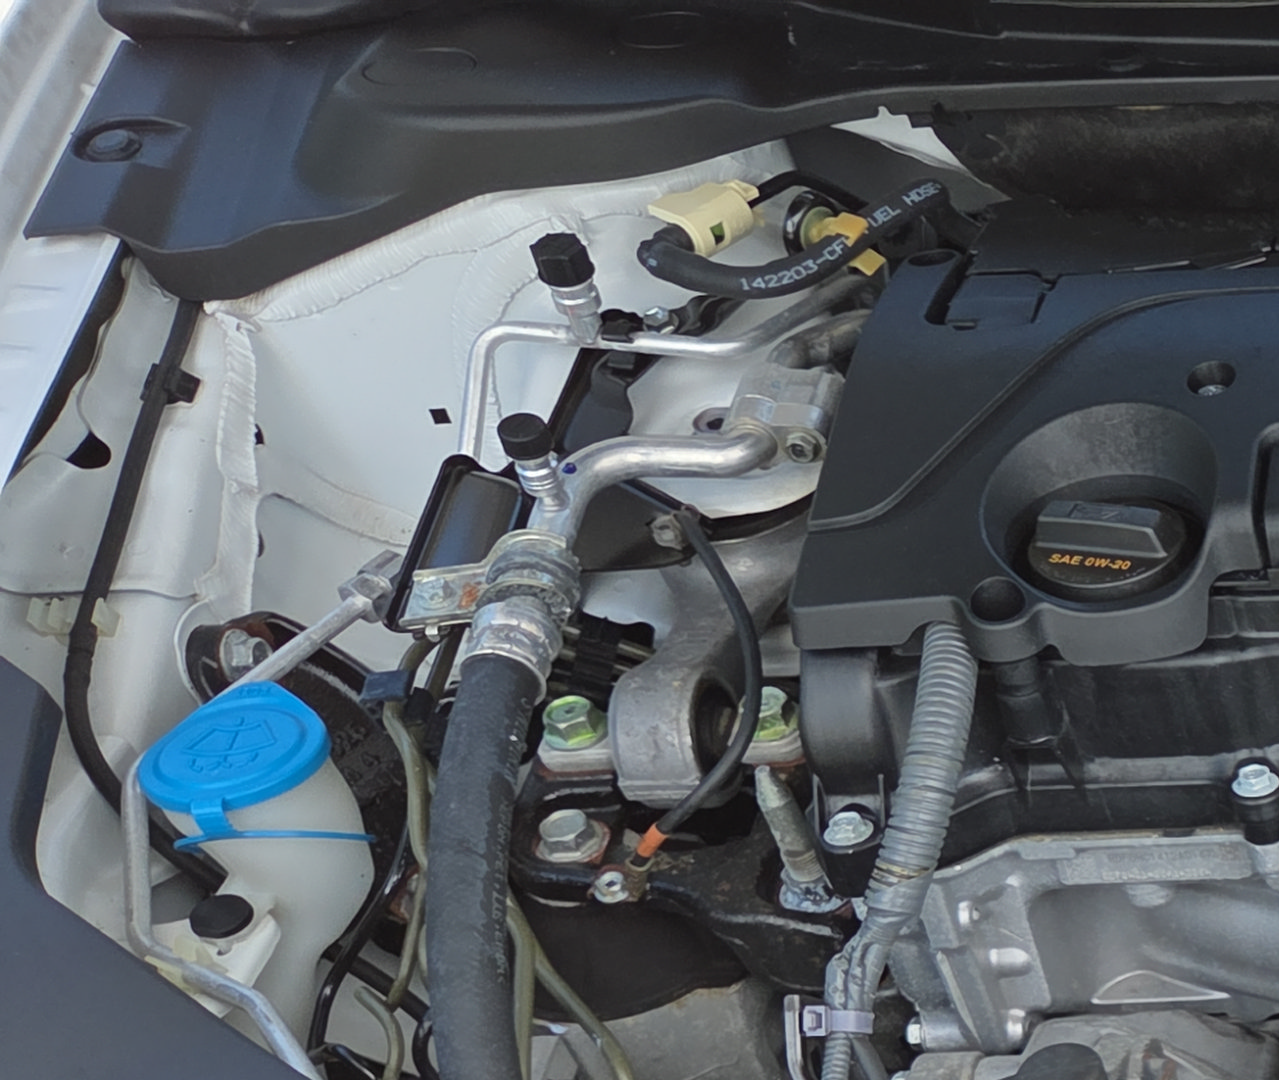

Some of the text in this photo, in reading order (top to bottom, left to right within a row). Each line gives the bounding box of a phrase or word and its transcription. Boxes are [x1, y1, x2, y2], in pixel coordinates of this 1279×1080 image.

[864, 205, 902, 234] UEL
[1048, 553, 1132, 571] SAE 0W-20
